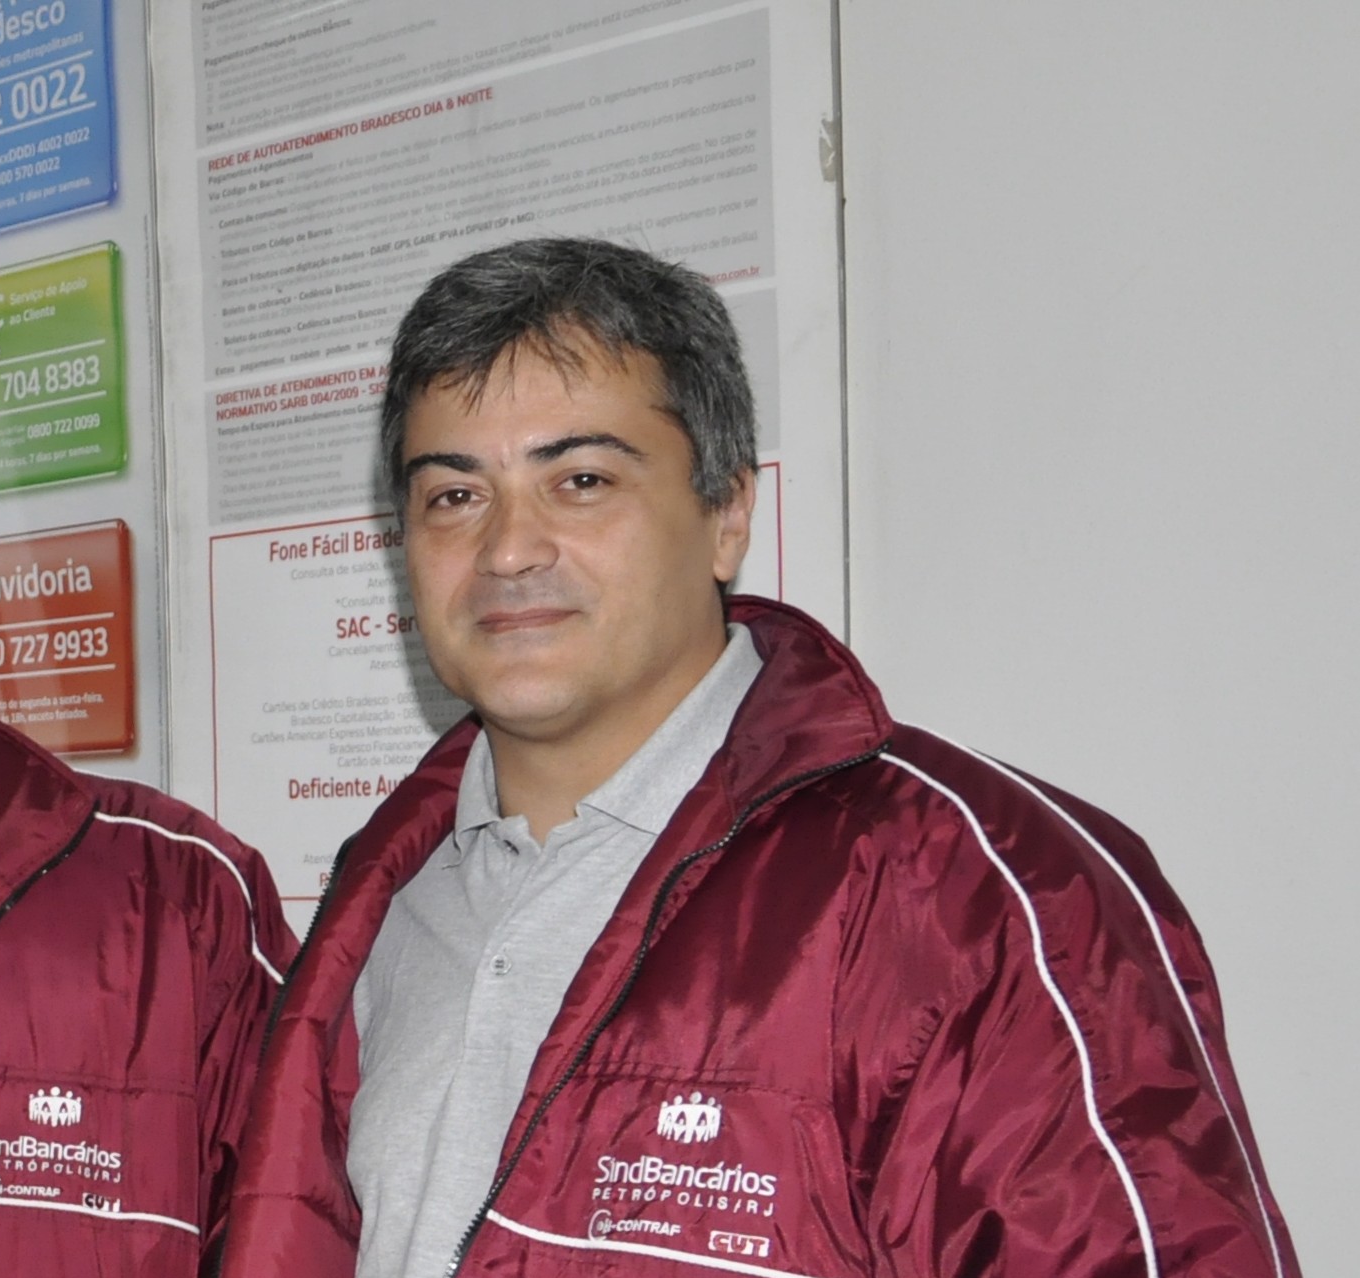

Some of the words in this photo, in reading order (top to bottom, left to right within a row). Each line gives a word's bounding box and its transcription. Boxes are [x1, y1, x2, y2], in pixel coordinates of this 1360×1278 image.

[13, 32, 83, 63] metropolitanas
[11, 64, 87, 119] 0022
[38, 135, 62, 153] 4002
[64, 127, 89, 145] 0022
[208, 155, 234, 173] REDE
[237, 150, 251, 164] DE
[254, 123, 358, 159] AUTOATENDIMENTO
[361, 107, 420, 134] BRADESCO
[423, 100, 443, 116] DIA
[446, 98, 454, 109] &
[457, 87, 494, 108] NOITE
[15, 165, 32, 181] 570
[35, 157, 60, 174] 0022
[10, 288, 42, 306] Serviço
[46, 285, 57, 296] de
[60, 278, 87, 294] Apoio
[10, 314, 21, 325] ao
[24, 305, 55, 321] Cliente
[0, 370, 41, 402] 704
[45, 355, 100, 393] 8383
[216, 384, 261, 405] DIRETIVA
[264, 381, 277, 396] DE
[281, 368, 356, 393] ATENDIMENTO
[359, 367, 375, 380] EM
[216, 401, 277, 421] NORMATIVO
[280, 394, 308, 410] SARB
[310, 387, 359, 406] 004/2009
[294, 408, 341, 425] Atendimento
[27, 423, 51, 439] 0800
[54, 418, 72, 434] 722
[74, 413, 100, 429] 0099
[270, 541, 307, 562] Fone
[312, 532, 349, 557] Fácil
[354, 528, 404, 551] Brade
[290, 562, 333, 581] Consulta
[336, 565, 349, 574] de
[336, 616, 370, 639] SAC
[10, 633, 49, 665] 727
[53, 627, 108, 660] 9933
[312, 698, 343, 710] Crédito
[347, 694, 389, 708] Bradesco
[28, 711, 54, 722] exceto
[291, 714, 331, 726] Bradesco
[334, 710, 395, 724] Capitalização
[287, 730, 328, 743] American
[330, 728, 364, 741] Express
[367, 724, 421, 738] Membership
[330, 742, 371, 754] Bradesco
[337, 757, 368, 768] Cartão
[289, 778, 371, 799] Deficiente
[595, 1155, 777, 1196] SindBancários
[591, 1186, 774, 1217] PETRÓPOLIS/RJ
[710, 1230, 770, 1257] CUT
